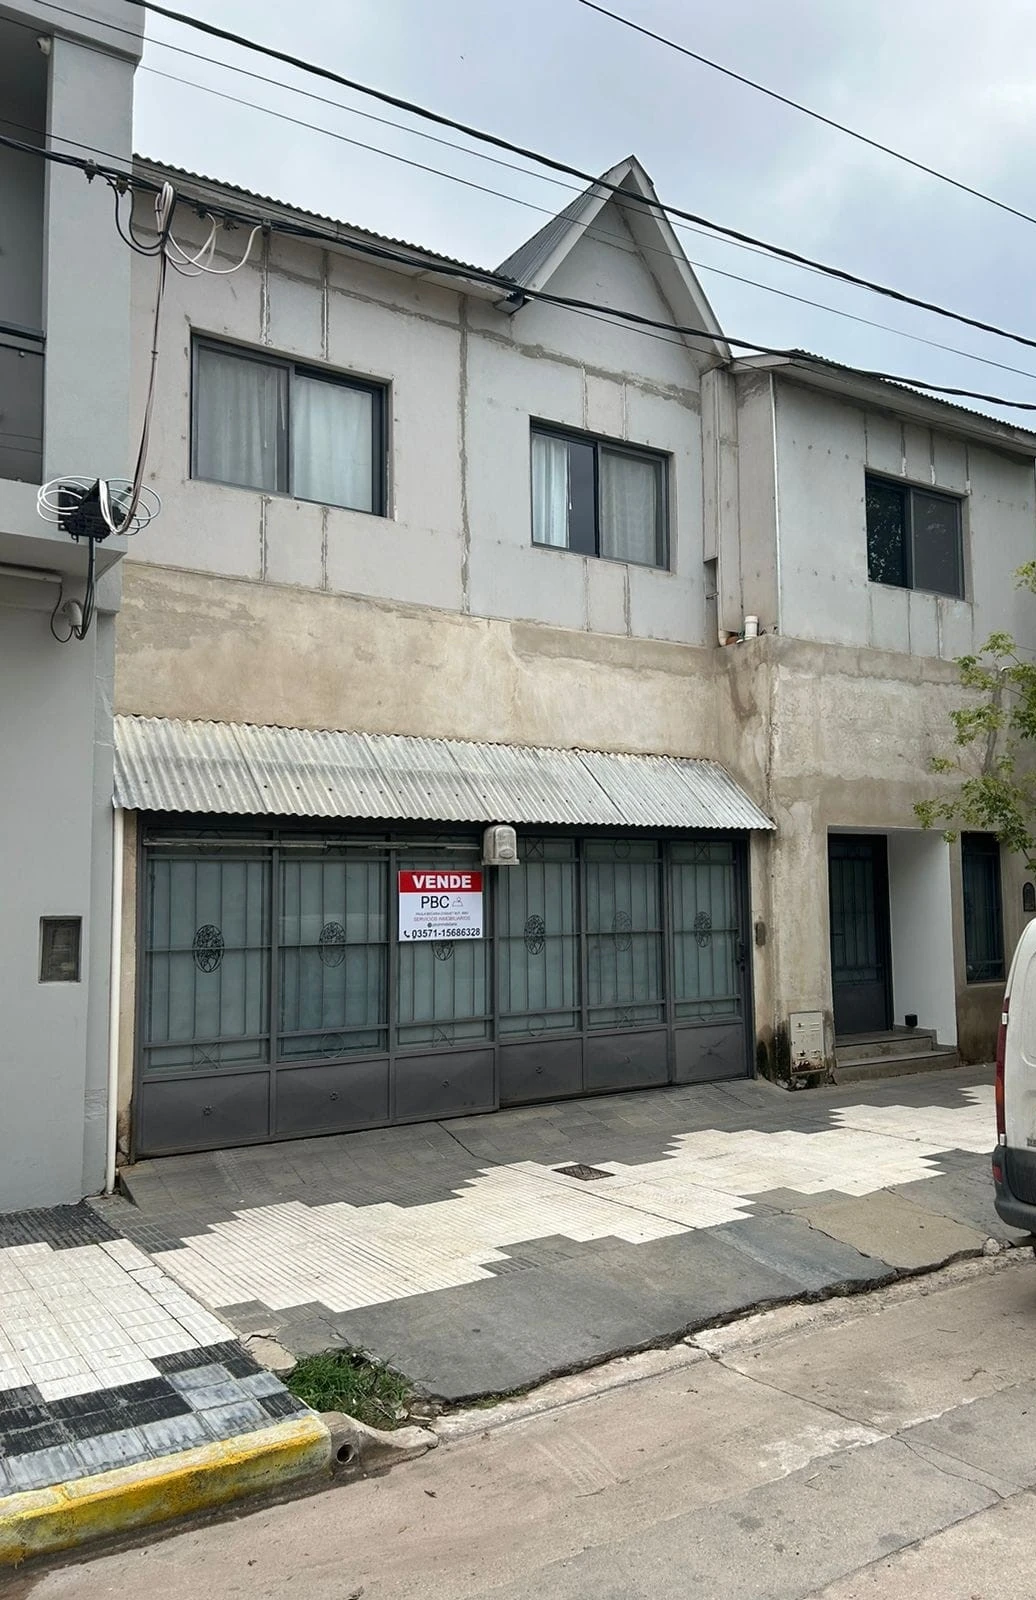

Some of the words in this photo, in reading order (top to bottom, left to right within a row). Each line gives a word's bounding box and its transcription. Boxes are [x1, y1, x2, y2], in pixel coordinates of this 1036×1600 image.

[412, 875, 472, 889] VENDE
[421, 896, 450, 908] PBC
[411, 928, 481, 939] 03571-15686328
